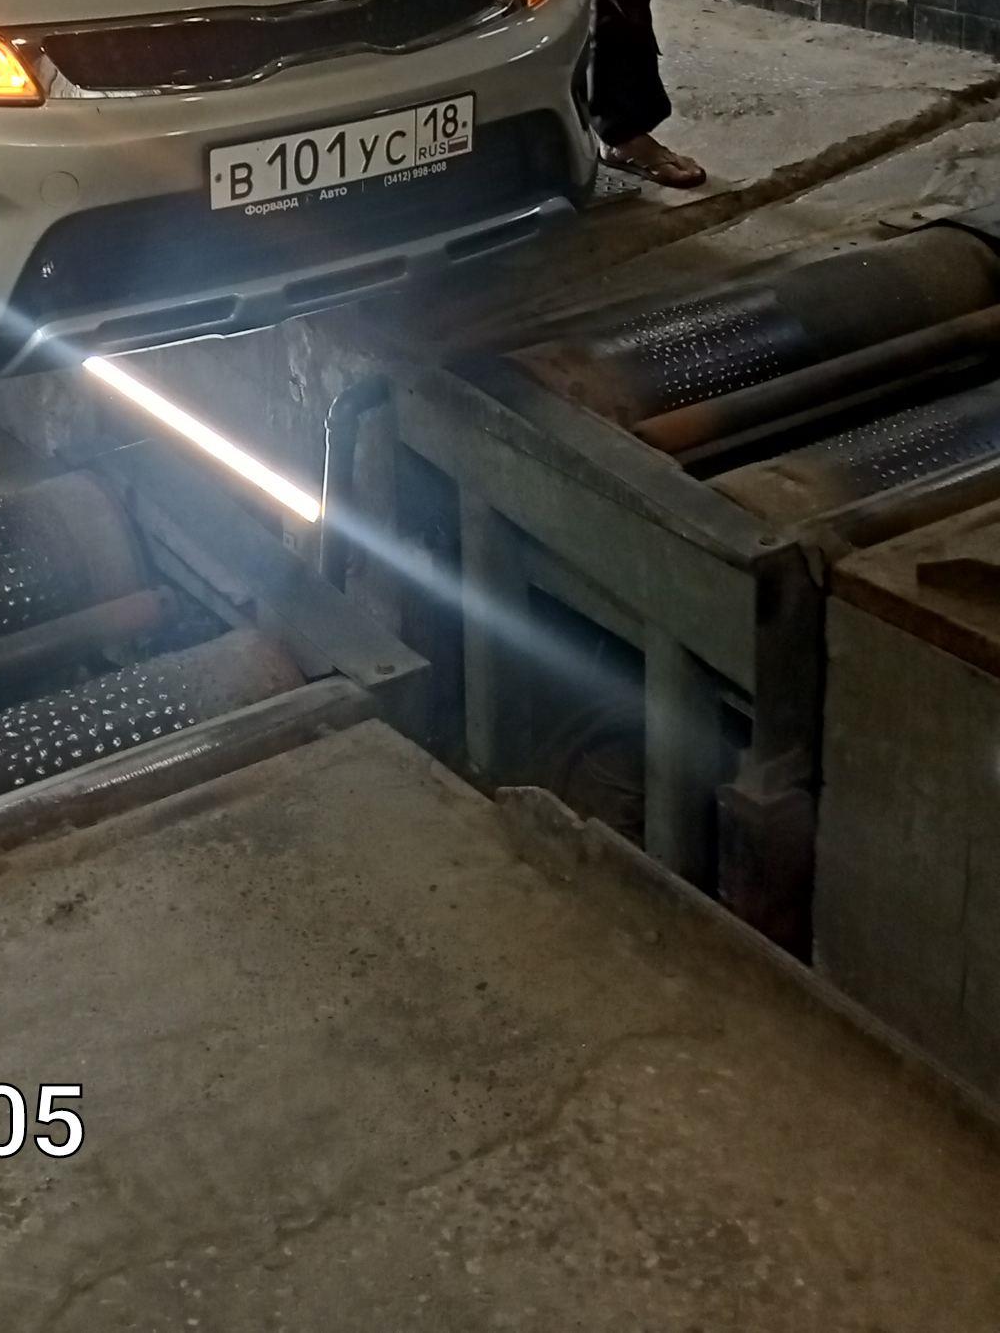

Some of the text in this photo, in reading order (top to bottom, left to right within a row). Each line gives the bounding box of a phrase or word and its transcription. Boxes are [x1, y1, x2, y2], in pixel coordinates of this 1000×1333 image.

[423, 104, 459, 142] 18
[418, 142, 447, 159] RUS
[244, 185, 348, 216] Форвард Авто
